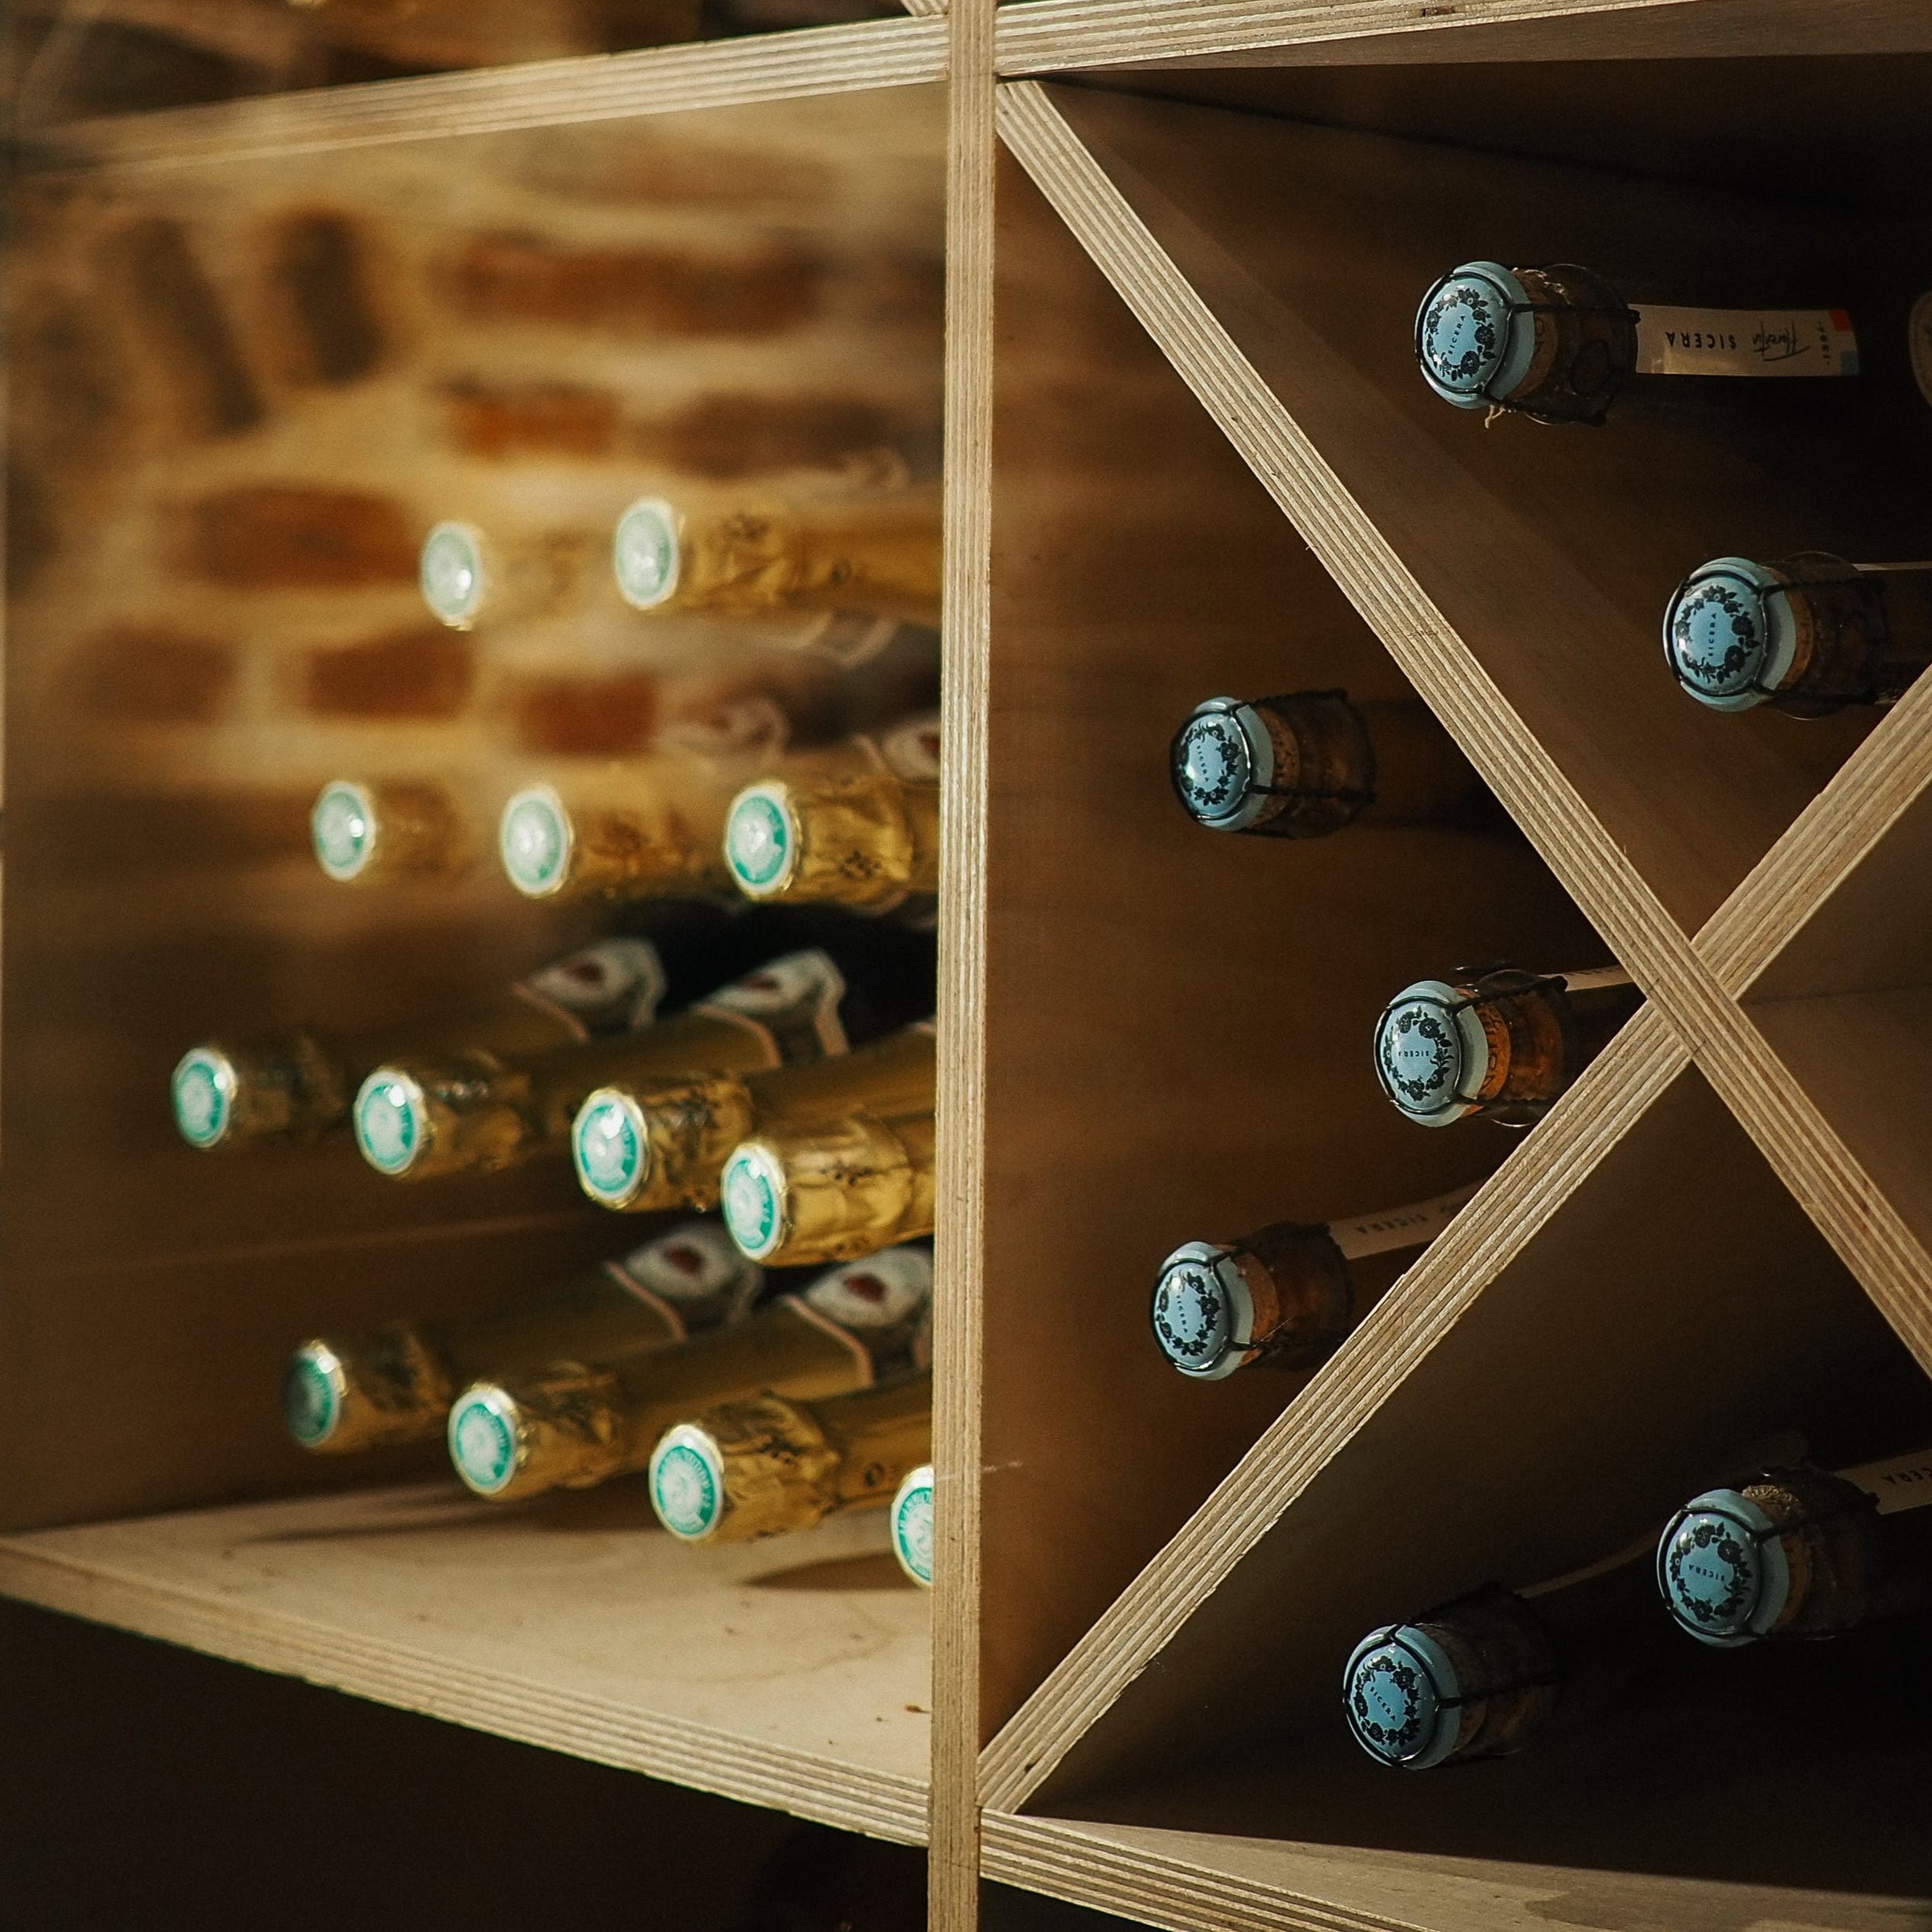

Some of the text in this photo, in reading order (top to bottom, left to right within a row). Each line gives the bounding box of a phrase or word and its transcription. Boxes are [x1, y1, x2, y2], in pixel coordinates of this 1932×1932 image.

[1447, 315, 1465, 355] SICERA
[1665, 330, 1736, 350] SICERA
[1707, 611, 1717, 658] SICERA
[1689, 1563, 1725, 1582] SICERA
[1370, 1686, 1397, 1722] SICERA
